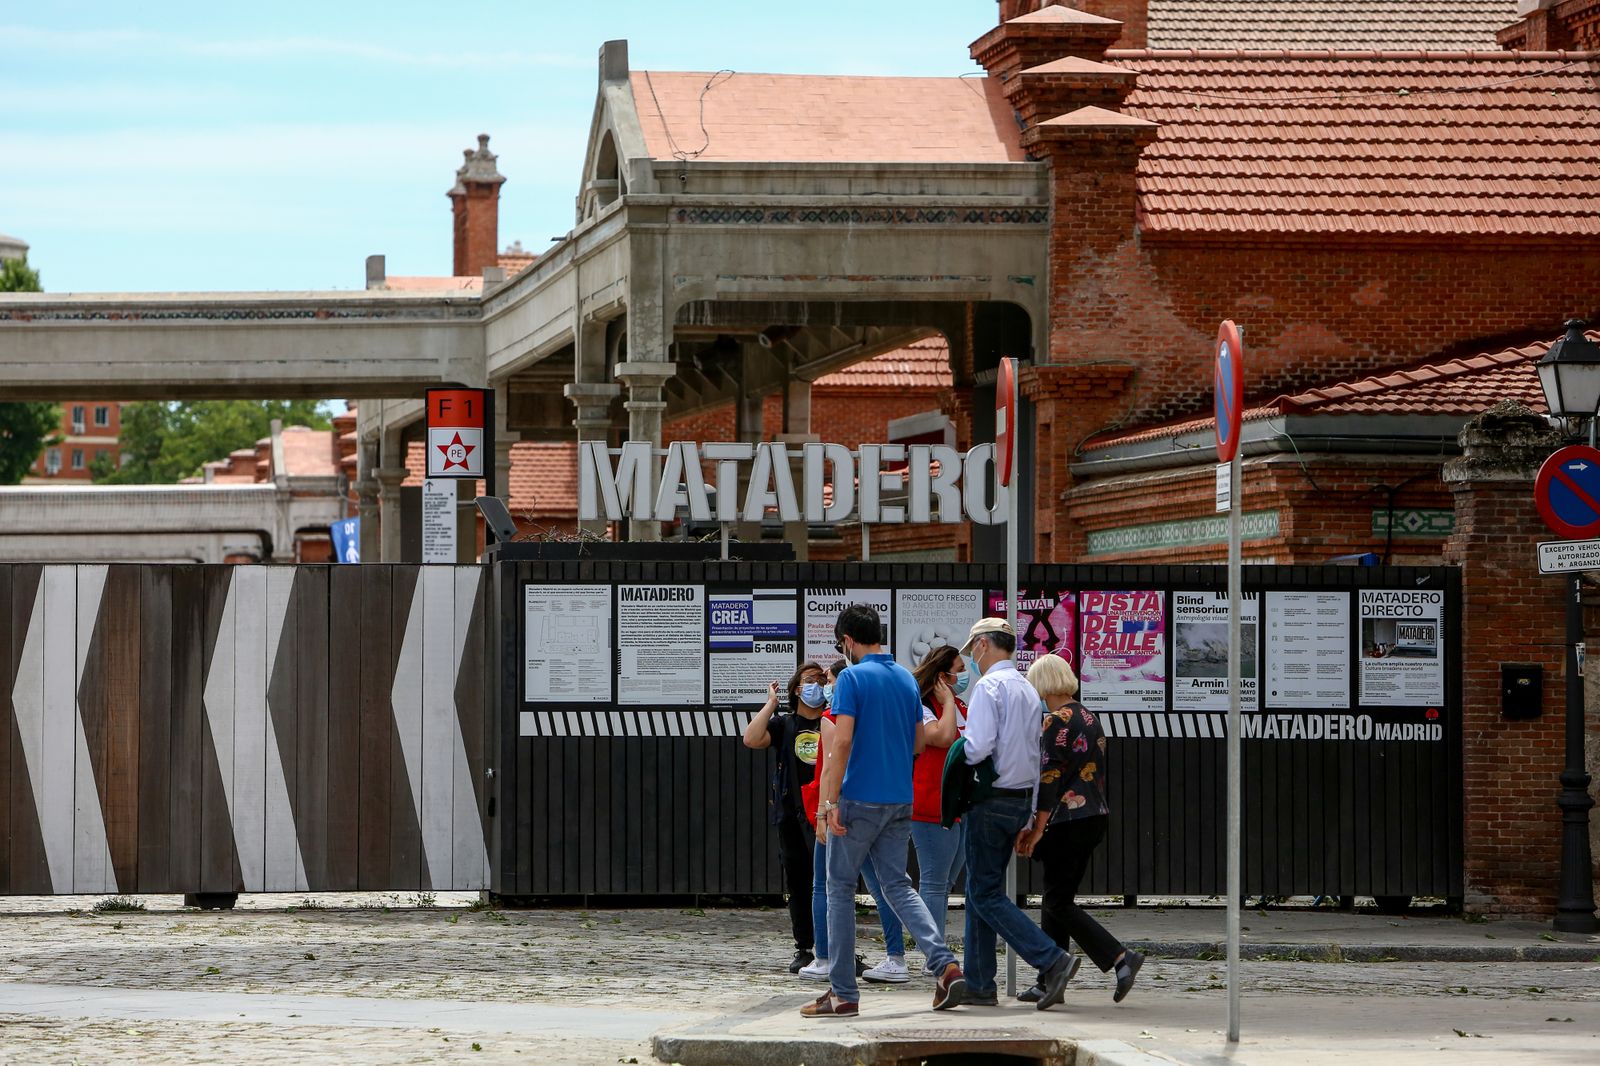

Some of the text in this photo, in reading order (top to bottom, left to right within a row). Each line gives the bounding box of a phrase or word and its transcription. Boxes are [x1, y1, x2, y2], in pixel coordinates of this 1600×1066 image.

[439, 398, 472, 419] F 1
[451, 449, 462, 458] PE
[577, 440, 1007, 525] MATADERO
[1558, 552, 1600, 560] AUTORIZADO
[620, 587, 695, 602] MATADERO
[902, 594, 977, 602] PRODUCTO FRESCO
[1176, 595, 1204, 605] Blind
[1361, 592, 1441, 604] MATADERO
[807, 600, 855, 614] Capítul
[996, 599, 1054, 611] FETIVAL
[1086, 593, 1160, 613] PISTA
[930, 609, 959, 617] HECHO
[1361, 604, 1424, 616] DIRECTO
[711, 610, 749, 625] CREA
[902, 617, 912, 625] EN
[1085, 614, 1120, 633] DE
[1399, 626, 1435, 640] MATADERO
[754, 643, 794, 653] 5-6MAR
[1084, 633, 1158, 651] BAILE
[1191, 678, 1224, 688] Armin
[1240, 714, 1443, 741] MATADERO MADRID
